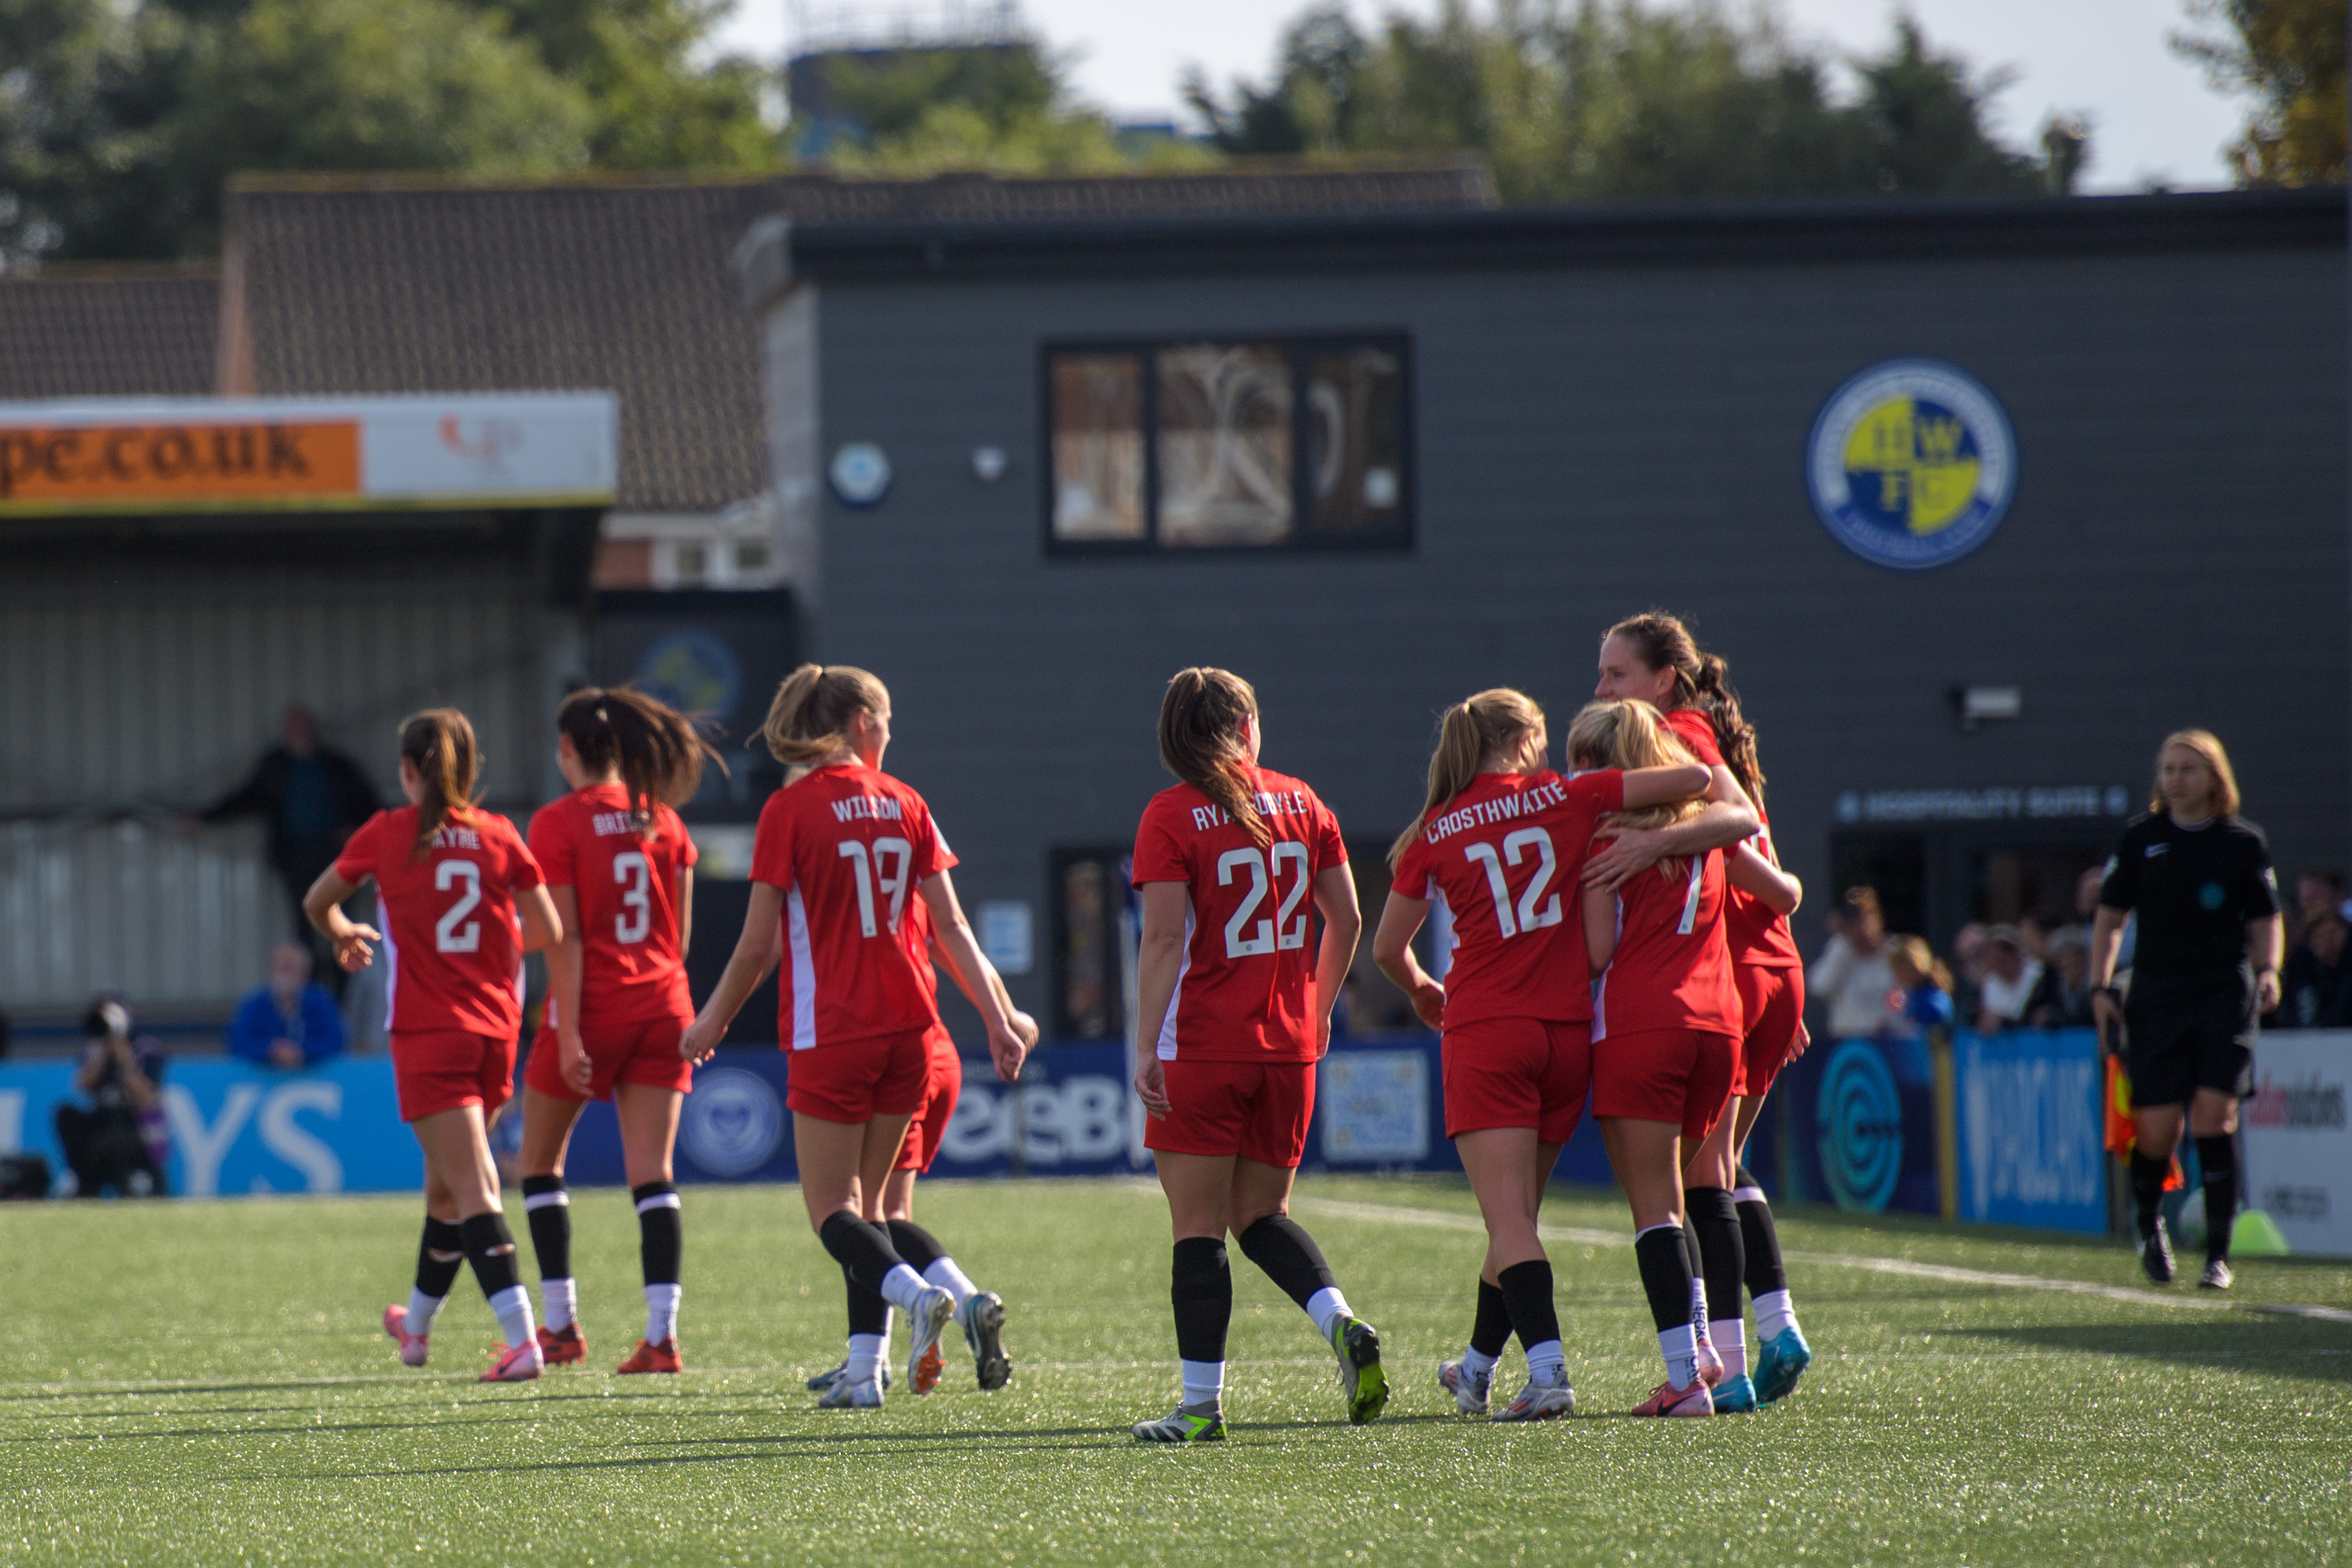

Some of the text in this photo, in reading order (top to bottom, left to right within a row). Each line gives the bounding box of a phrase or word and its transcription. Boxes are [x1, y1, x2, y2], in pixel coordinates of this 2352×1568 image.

[831, 794, 903, 823] WILSON
[1427, 781, 1568, 845] CROSTHWAITE
[435, 858, 481, 953] 2
[613, 851, 650, 945] 3
[838, 836, 912, 938] 19
[1217, 841, 1309, 959] 22
[1464, 825, 1563, 940] 12
